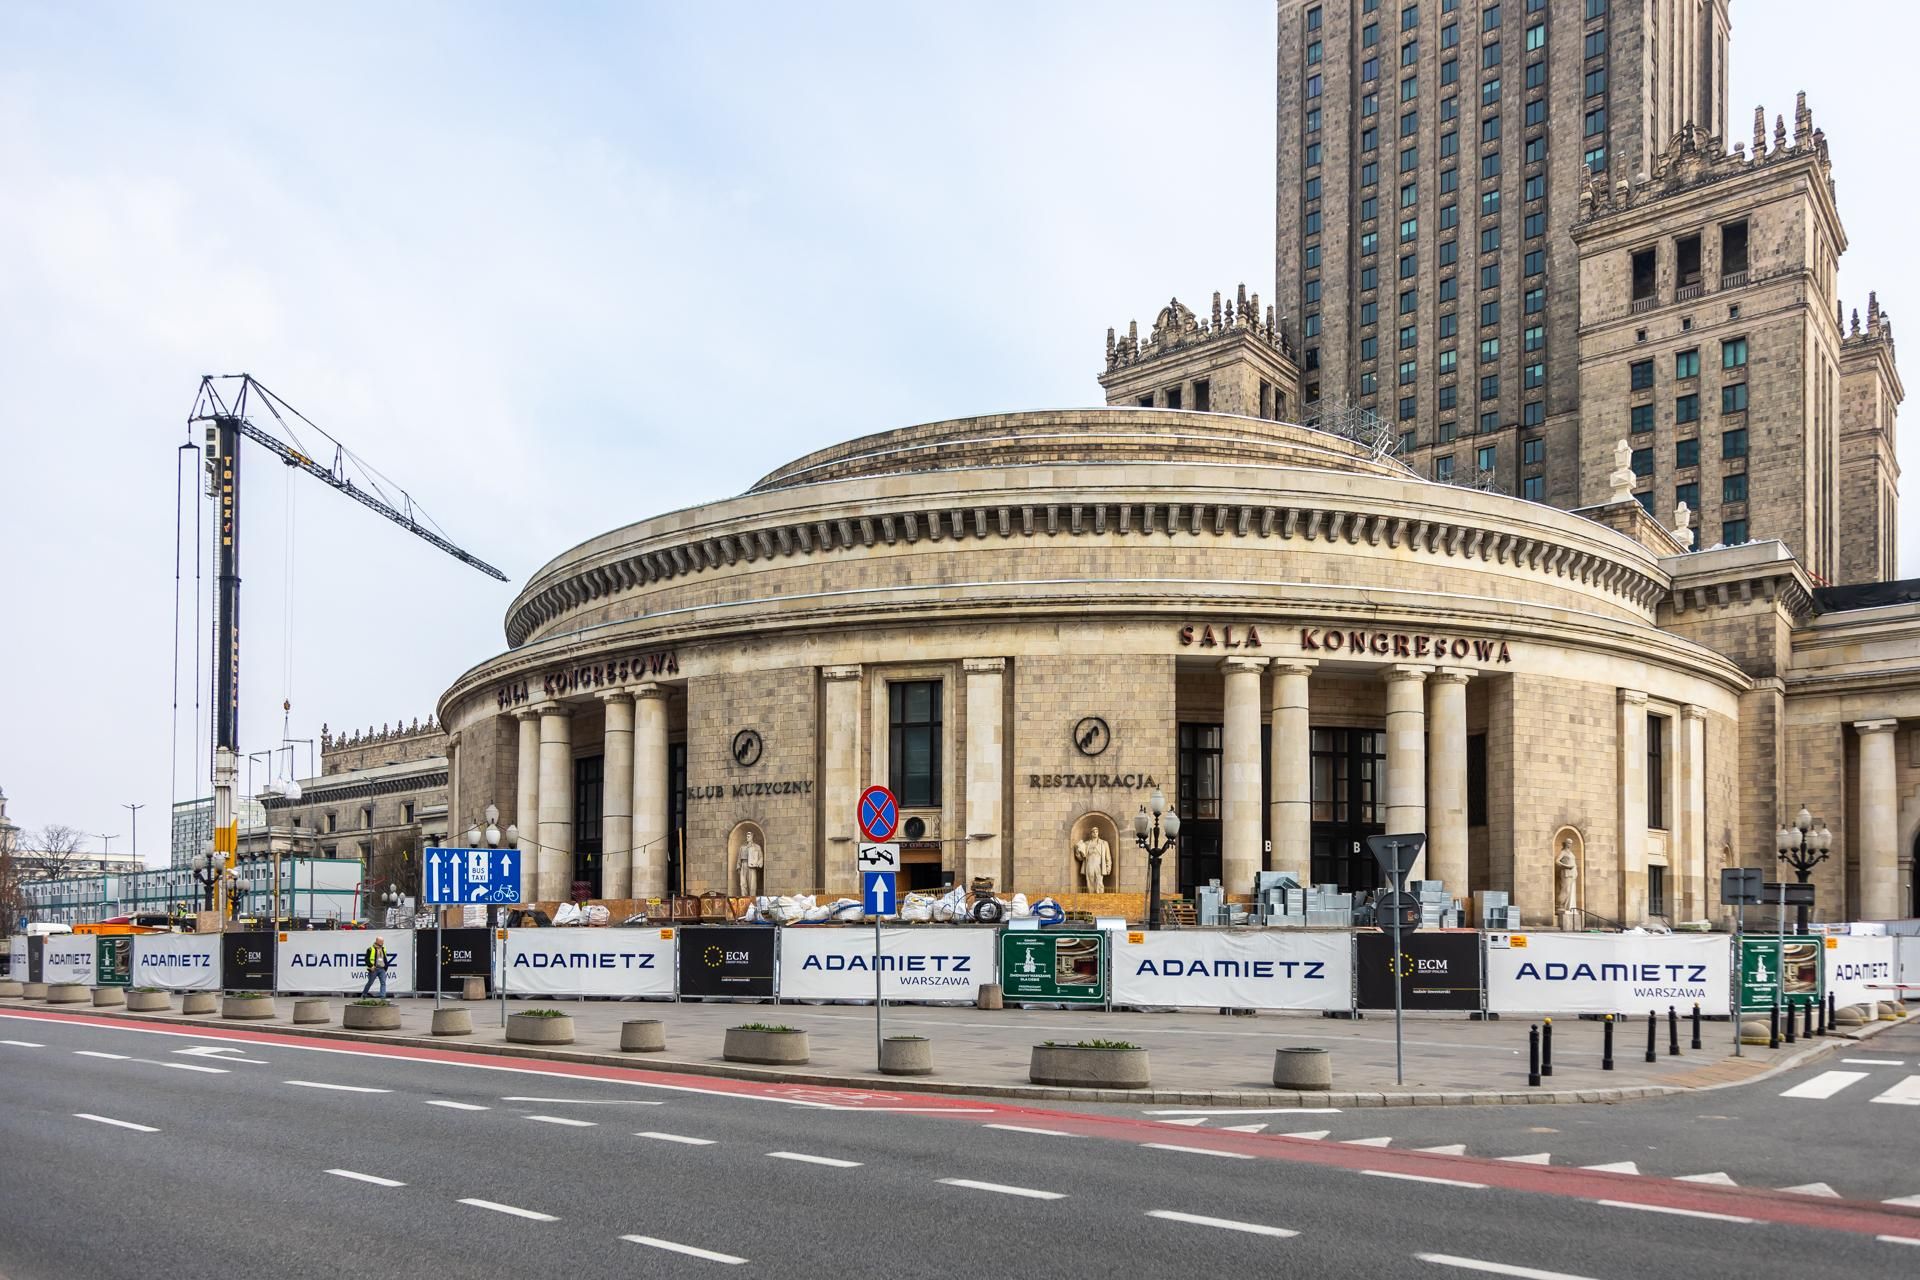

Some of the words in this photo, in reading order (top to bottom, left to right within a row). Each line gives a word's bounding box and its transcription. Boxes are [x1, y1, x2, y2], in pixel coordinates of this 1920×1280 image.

[1181, 624, 1262, 648] SALA
[1301, 627, 1512, 663] KONGRESOWA
[497, 681, 529, 711] SALA
[543, 651, 680, 696] KONGRESOWA
[1029, 774, 1157, 790] RESTAURACJA
[687, 785, 724, 800] KLUB
[732, 780, 814, 798] MUZYCZNY
[1353, 841, 1361, 853] B
[49, 953, 91, 965] ADAMIETZ
[141, 954, 210, 967] ADAMIETZ
[248, 952, 261, 960] ECM
[291, 953, 398, 967] ADAMIEZ
[453, 951, 472, 959] ECM
[513, 953, 655, 969] ADAMIETZ
[726, 951, 749, 960] ECM
[802, 954, 971, 971] ADAMIETZ
[1136, 959, 1325, 979] ADAMIETZ
[1418, 959, 1448, 970] ECM
[1515, 962, 1707, 982] ADAMIETZ
[1835, 962, 1888, 981] ADAMIETZ
[900, 976, 970, 986] WARSZAWA
[1634, 987, 1706, 998] WARSZAWA
